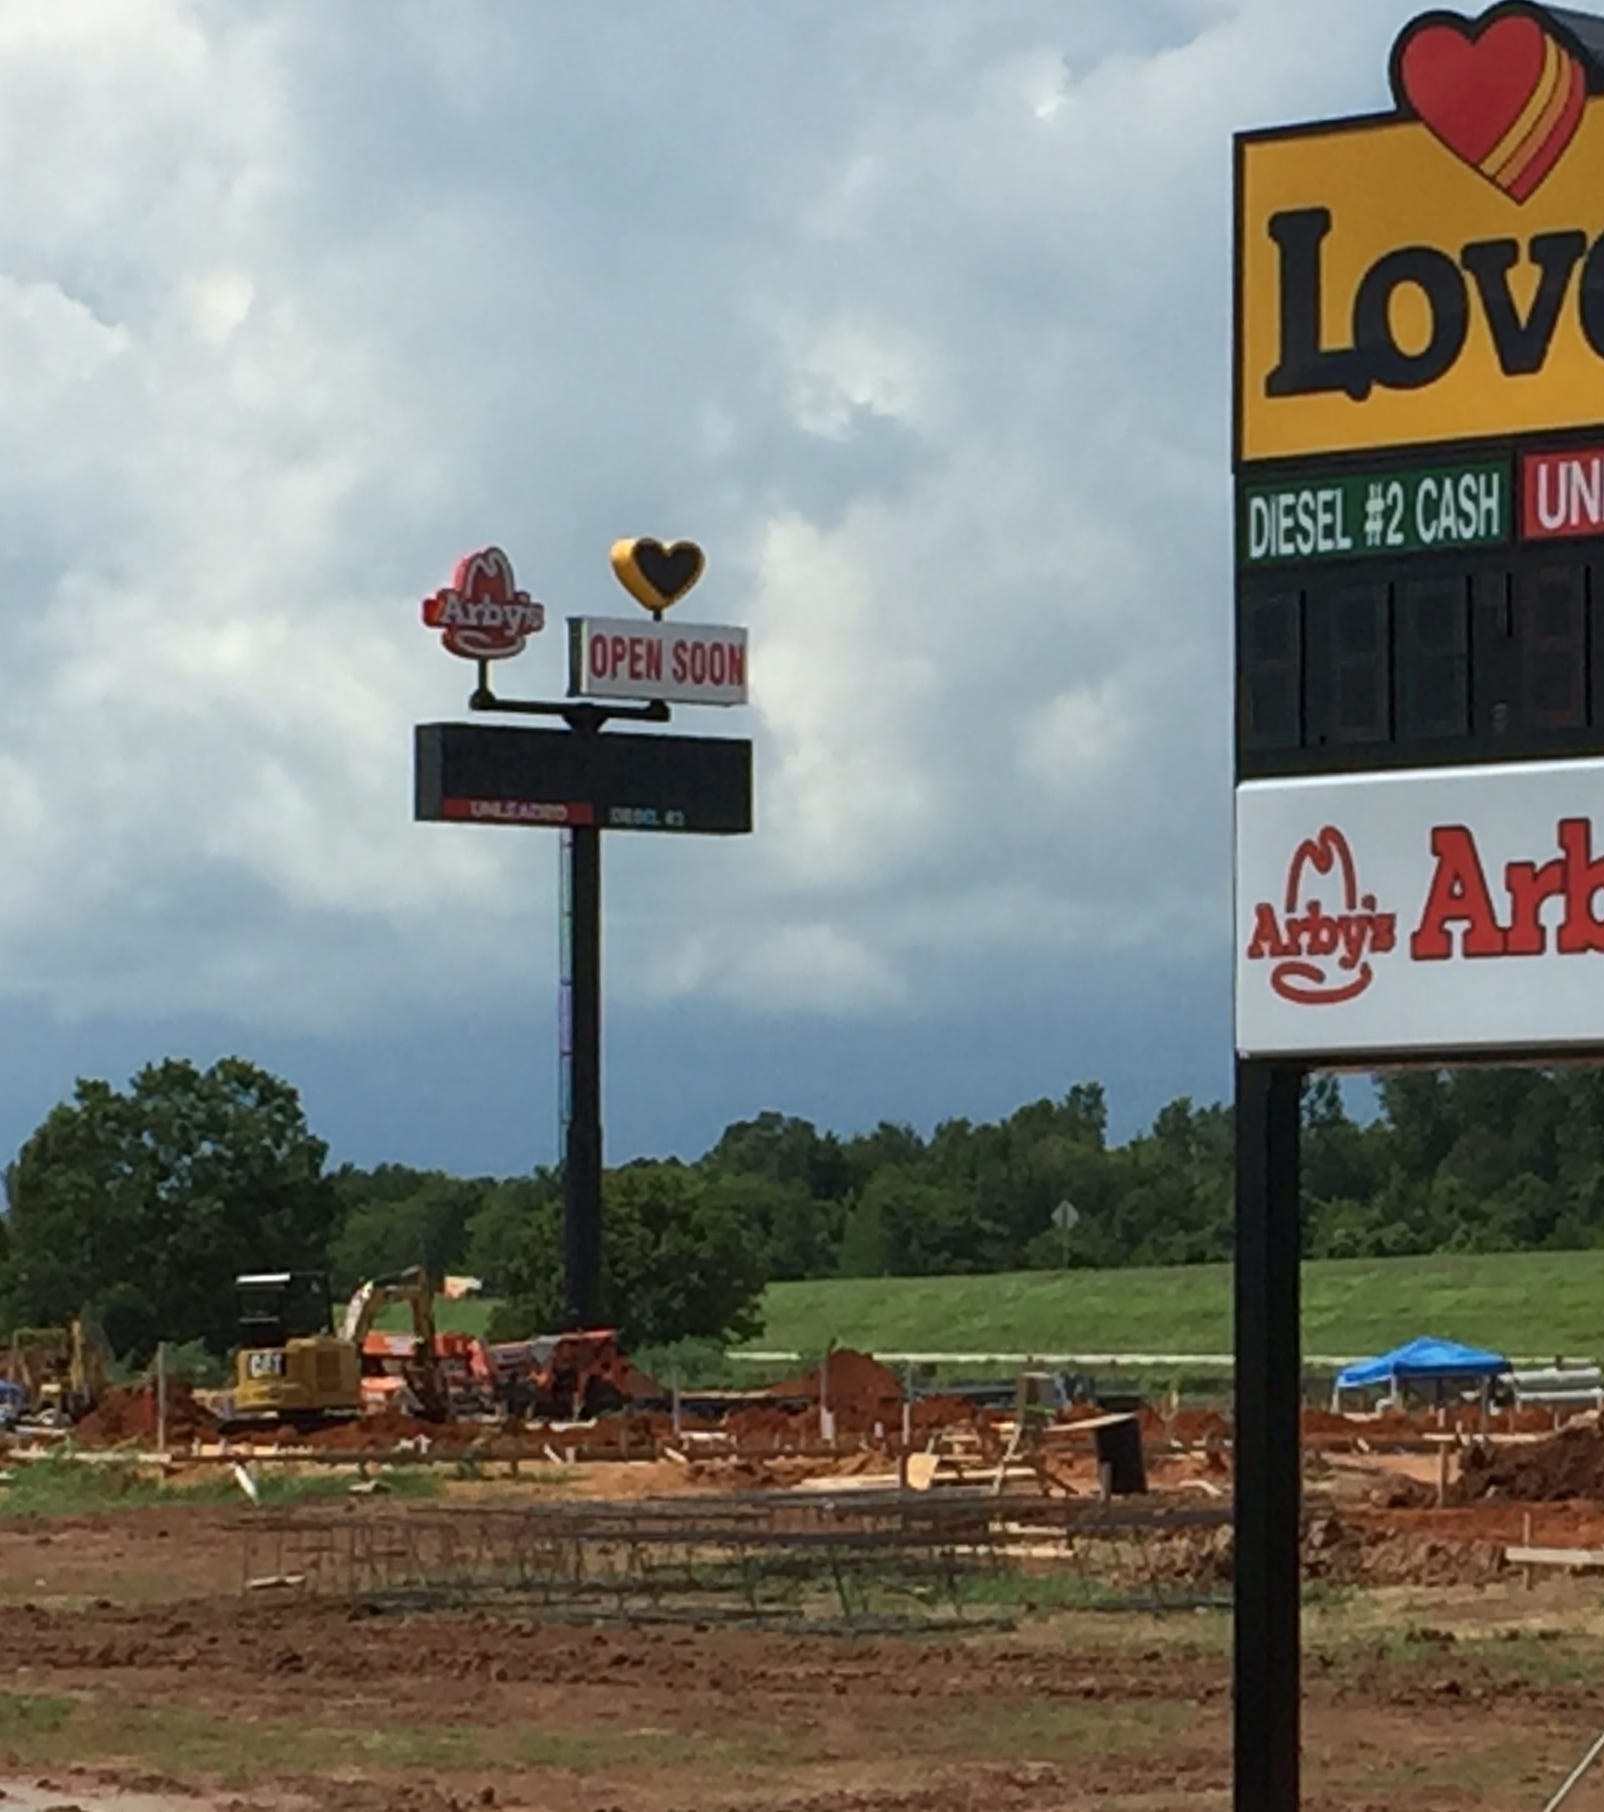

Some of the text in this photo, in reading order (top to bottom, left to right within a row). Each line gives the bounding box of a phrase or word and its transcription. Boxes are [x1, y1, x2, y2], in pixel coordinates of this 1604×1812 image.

[1248, 472, 1500, 559] DIESEL #2 CASH
[441, 587, 542, 637] Arby's
[590, 634, 744, 686] OPEN SOON
[470, 801, 568, 821] UNLEADED
[1247, 894, 1396, 967] Arby's
